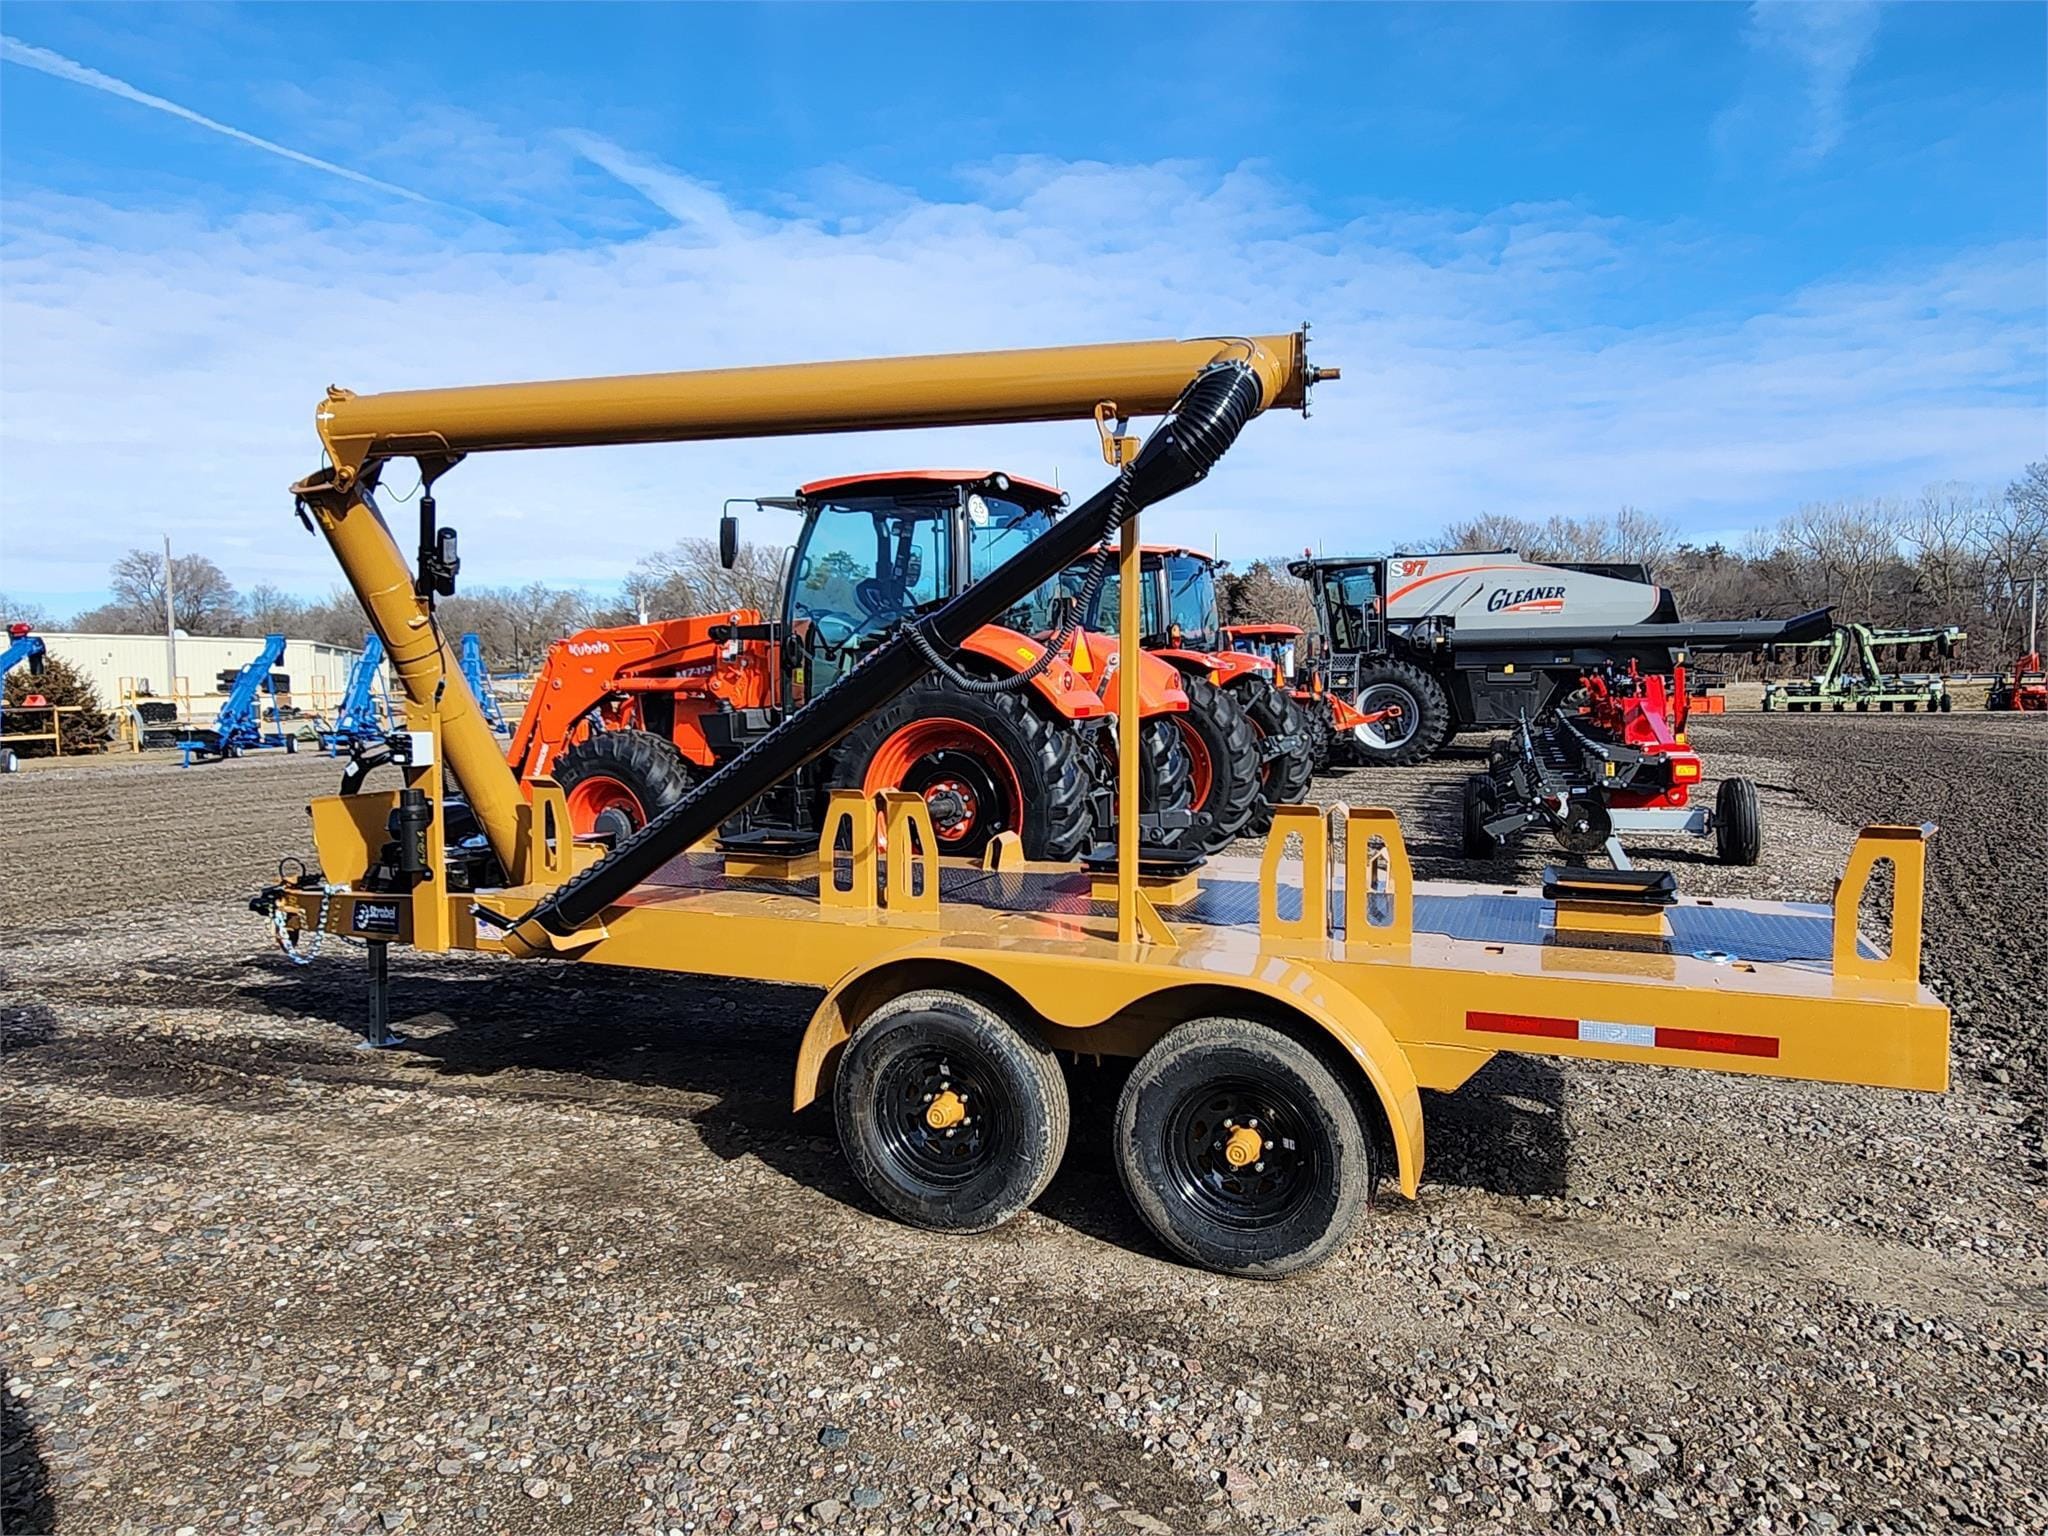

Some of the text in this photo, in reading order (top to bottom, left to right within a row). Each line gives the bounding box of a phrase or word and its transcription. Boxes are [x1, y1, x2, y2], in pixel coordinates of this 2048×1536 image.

[1390, 560, 1429, 577] S97
[1487, 586, 1566, 612] GLEANER
[568, 640, 611, 657] Kubota
